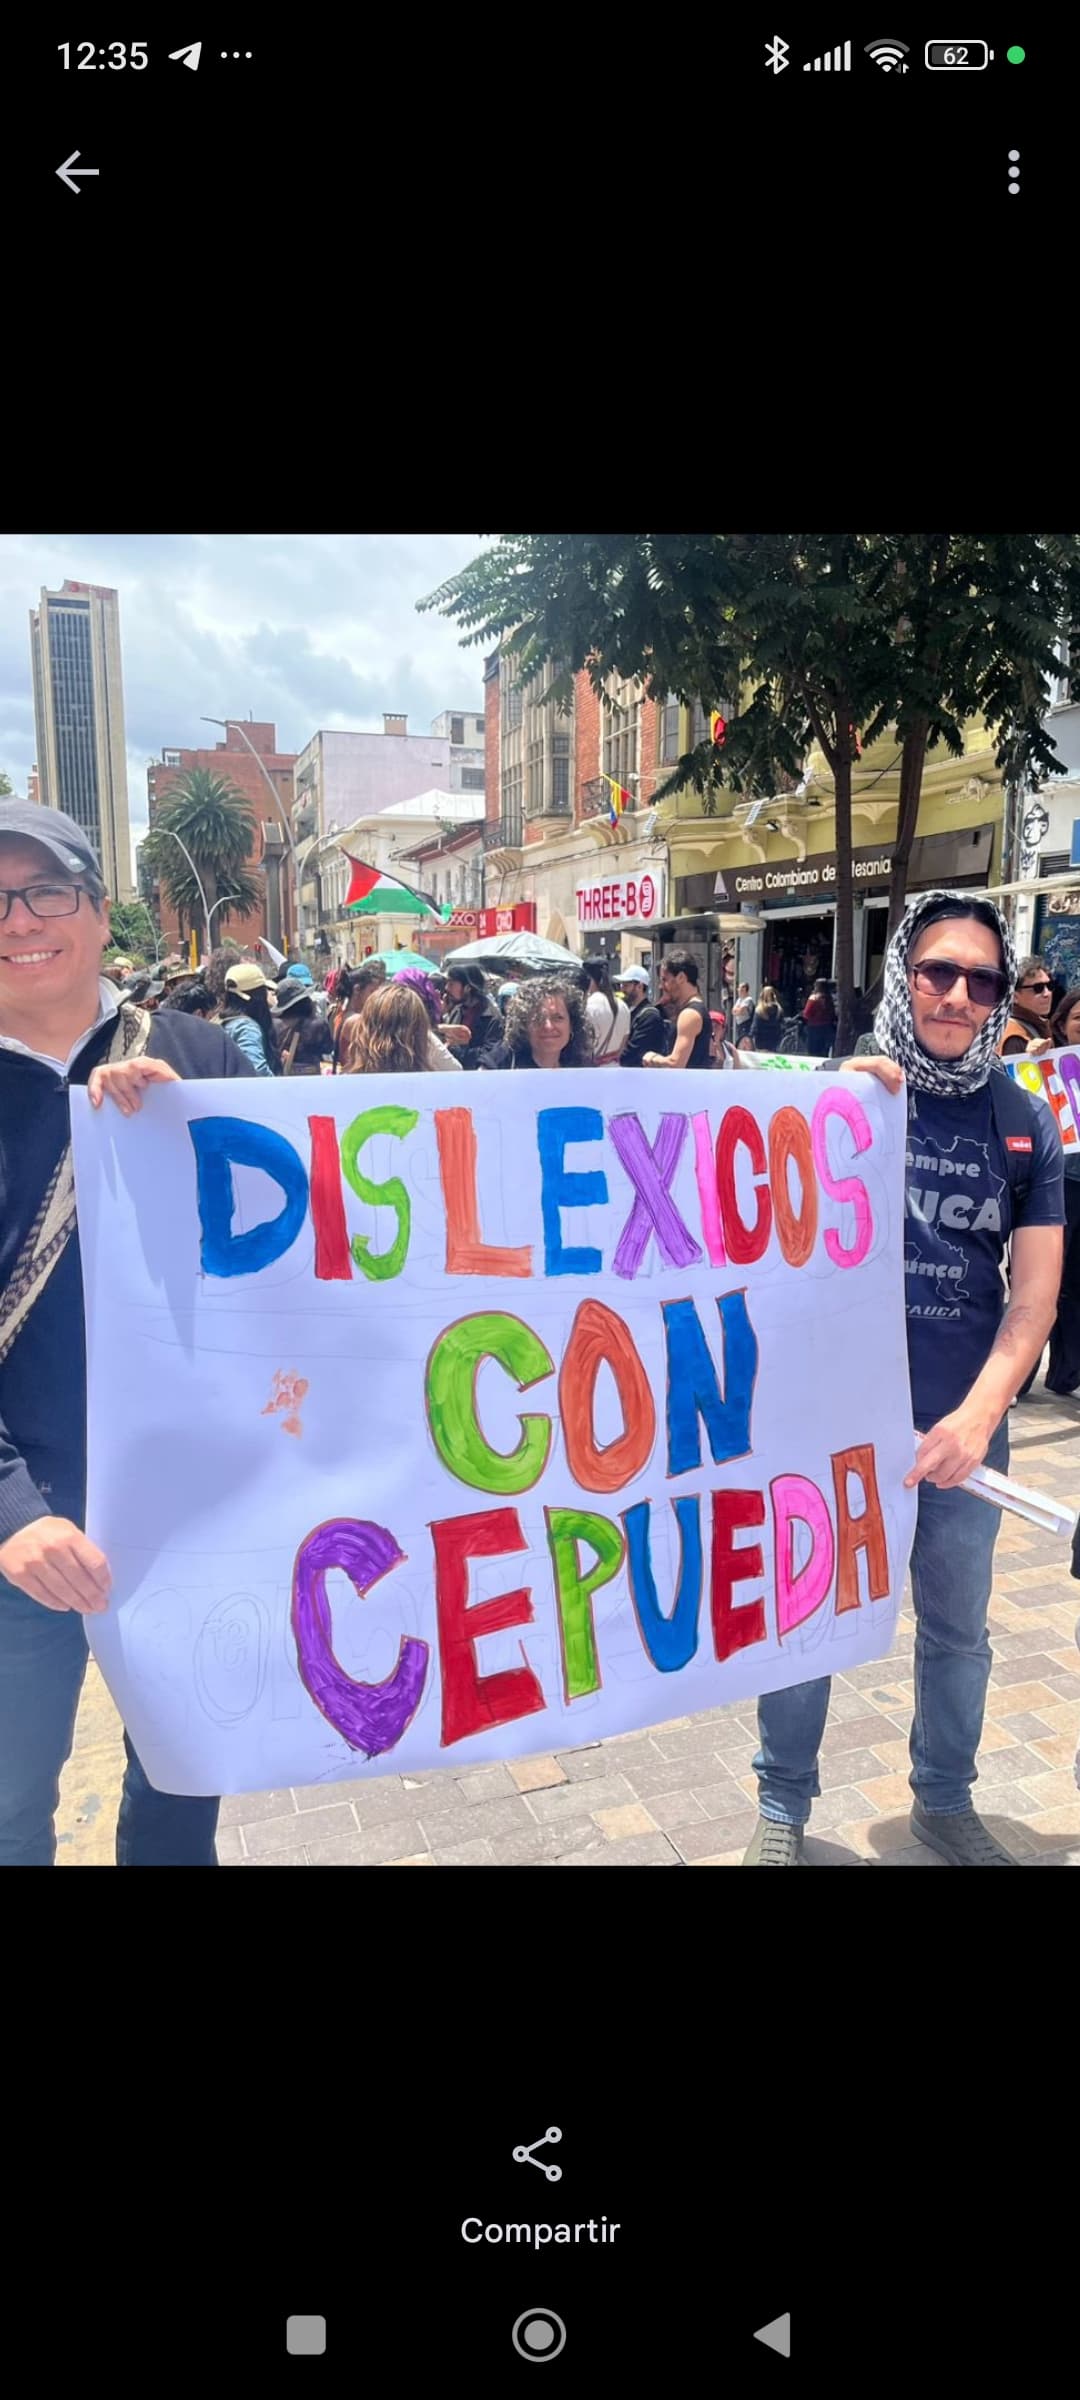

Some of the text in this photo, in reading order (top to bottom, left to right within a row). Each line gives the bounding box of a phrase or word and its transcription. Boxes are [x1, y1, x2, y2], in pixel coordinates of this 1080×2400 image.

[735, 877, 763, 893] Centro
[765, 867, 819, 890] Colombiano
[821, 864, 836, 882] de
[187, 1085, 874, 1281] DISLEXICOS
[904, 1151, 981, 1178] empre
[904, 1186, 1001, 1232] UCA
[904, 1259, 963, 1280] unca
[905, 1303, 962, 1318] AUCA
[426, 1287, 760, 1495] CON
[290, 1443, 891, 1757] CEPUEDA
